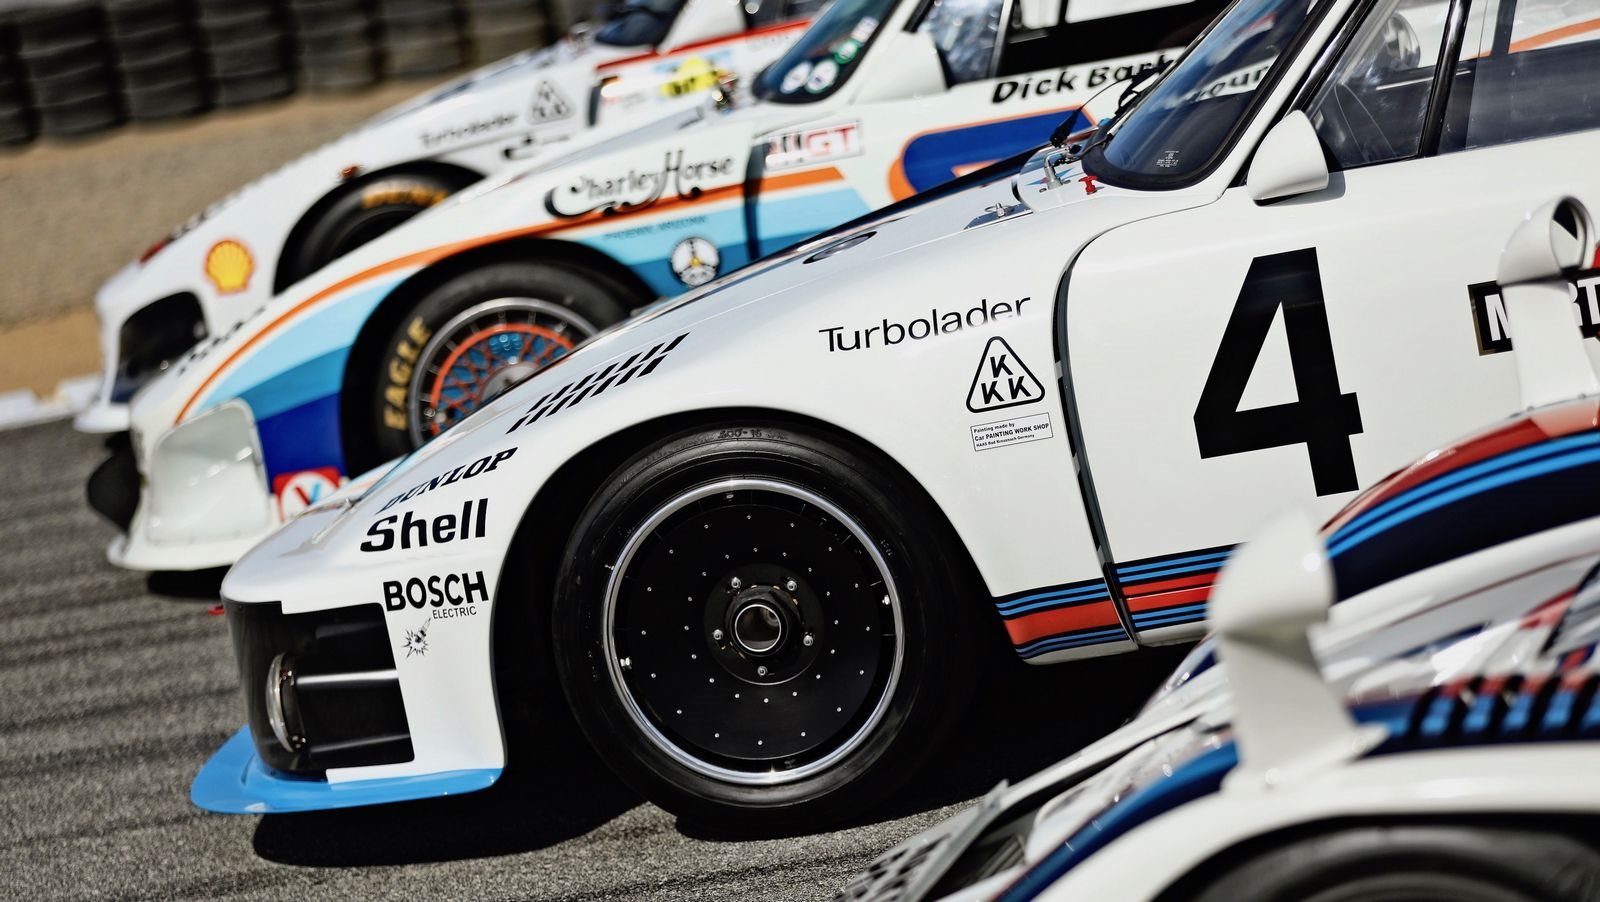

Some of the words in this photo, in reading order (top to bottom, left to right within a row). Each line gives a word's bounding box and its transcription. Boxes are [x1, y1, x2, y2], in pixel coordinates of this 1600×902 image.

[991, 70, 1078, 104] Dick
[664, 149, 733, 200] Horse
[818, 296, 1031, 352] Turbolader
[384, 315, 432, 431] EAGLE
[1193, 246, 1364, 498] 4
[986, 430, 1013, 439] PAINTING
[1015, 426, 1032, 434] WORK
[1033, 423, 1049, 431] SHOP
[375, 447, 519, 515] DUNLOP
[360, 497, 489, 552] Shell
[382, 570, 490, 613] BOSCH
[432, 605, 478, 620] ELECTRIC
